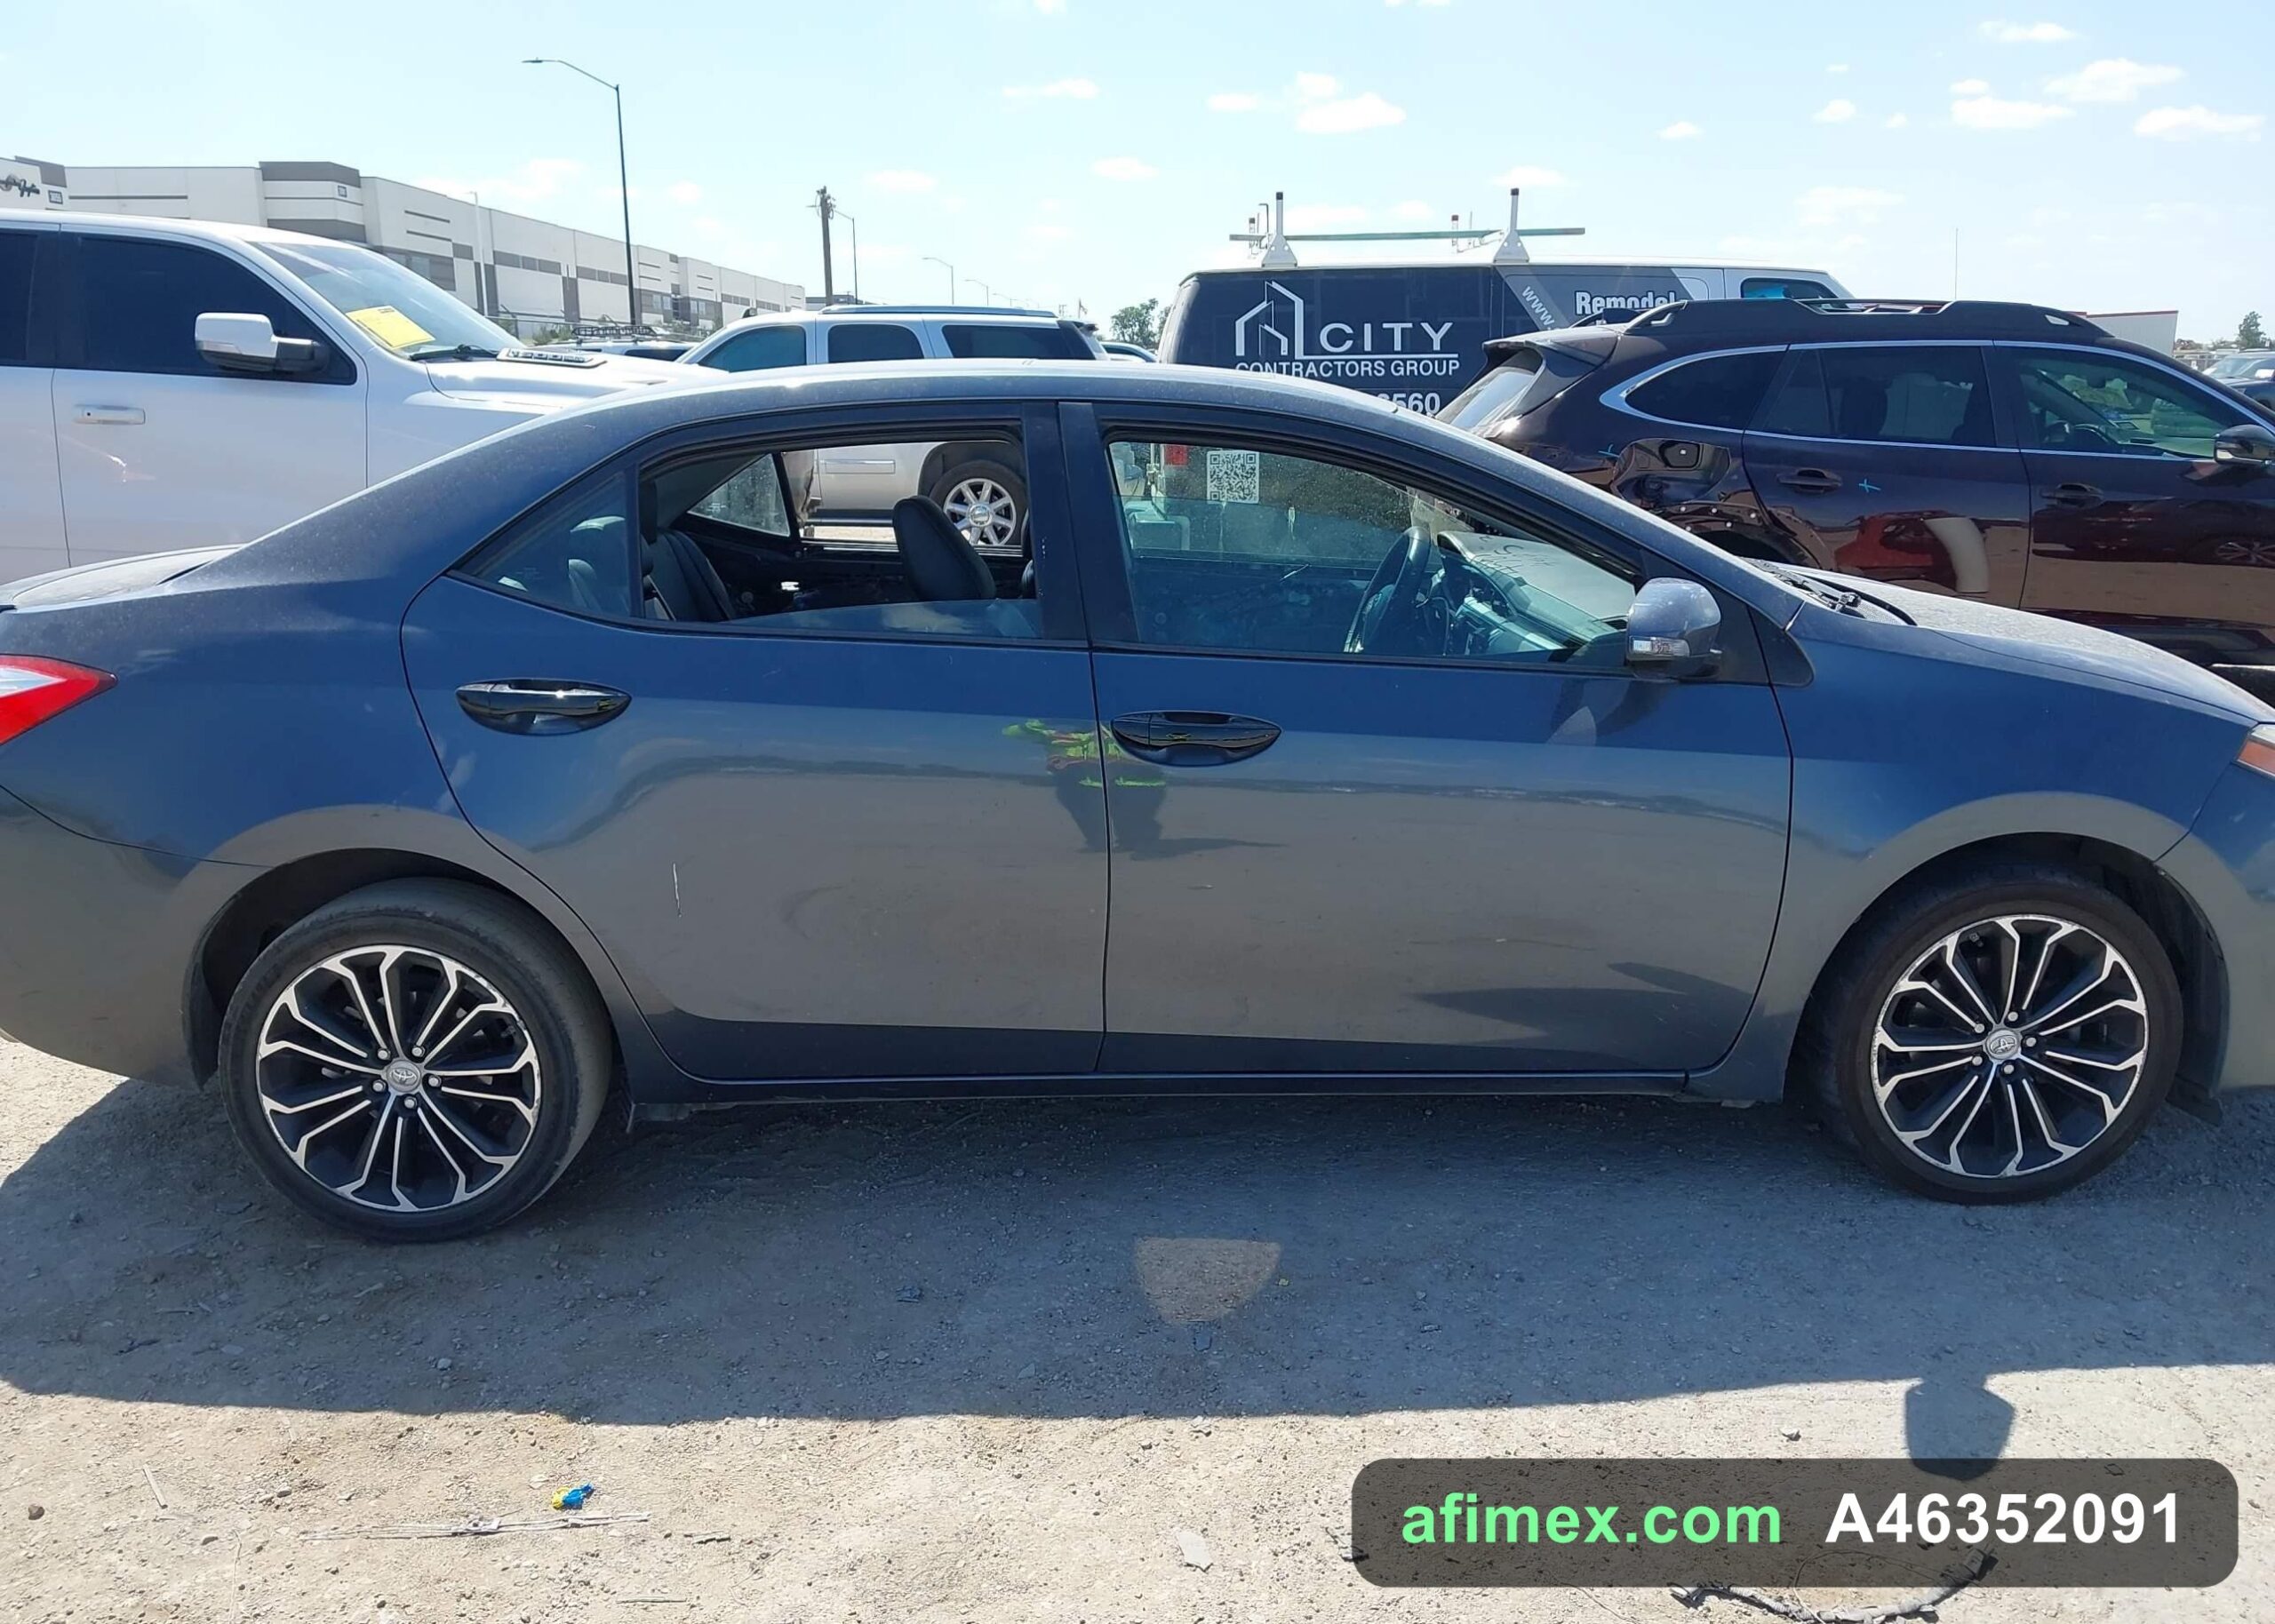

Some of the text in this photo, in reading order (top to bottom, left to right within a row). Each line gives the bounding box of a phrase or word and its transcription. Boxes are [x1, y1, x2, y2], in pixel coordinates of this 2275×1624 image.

[1320, 322, 1453, 353] CITY
[1391, 360, 1460, 377] GROUP
[1377, 392, 1441, 415] 560
